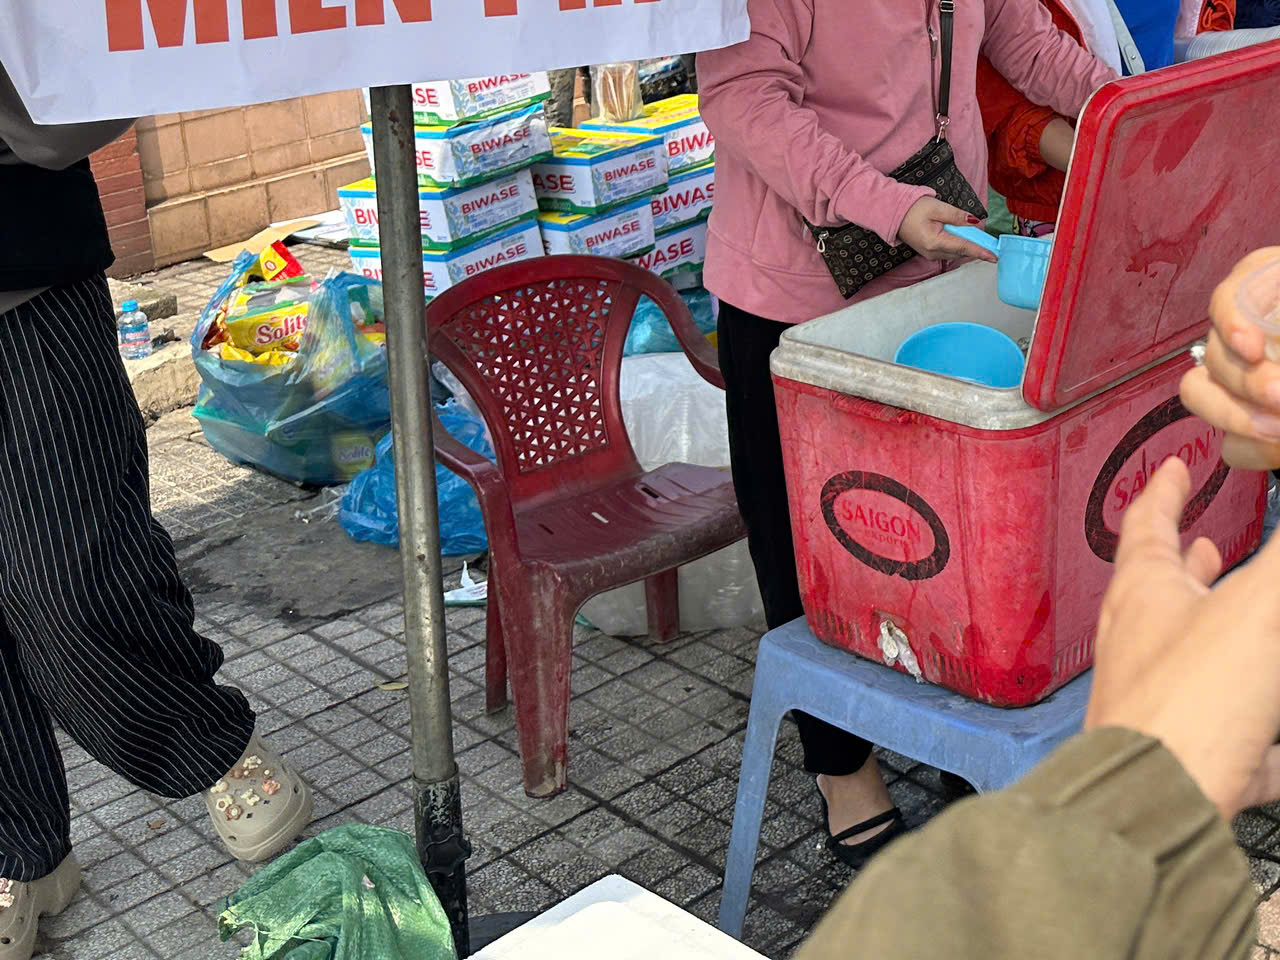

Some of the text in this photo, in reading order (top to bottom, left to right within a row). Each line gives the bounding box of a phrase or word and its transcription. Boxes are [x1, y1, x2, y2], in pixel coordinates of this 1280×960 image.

[471, 126, 531, 155] BIWASE
[604, 157, 656, 182] BIWASE
[462, 184, 520, 214] BIWASE
[586, 220, 641, 248] BIWASE
[465, 243, 527, 276] BIWASE
[842, 500, 921, 541] SAIGON
